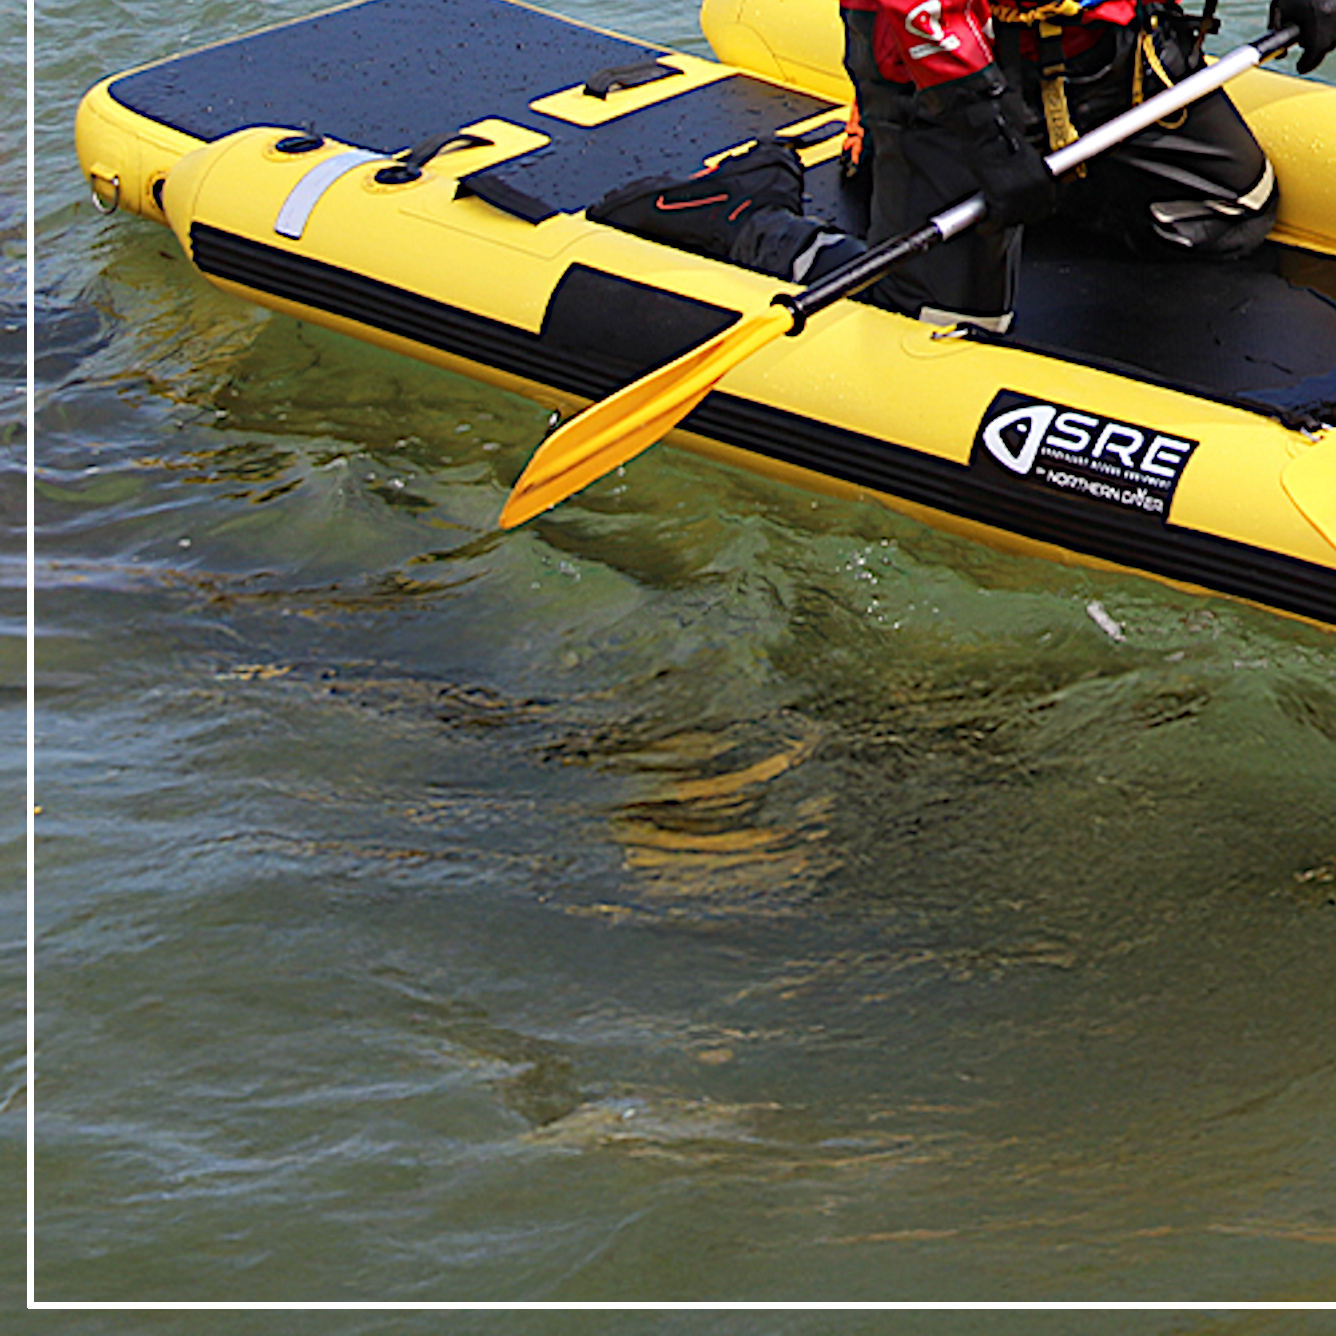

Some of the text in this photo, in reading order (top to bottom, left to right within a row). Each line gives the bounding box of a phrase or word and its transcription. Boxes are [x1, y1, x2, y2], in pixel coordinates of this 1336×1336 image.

[1045, 411, 1191, 479] SRE
[1046, 469, 1164, 514] NORTHERN DIVER
